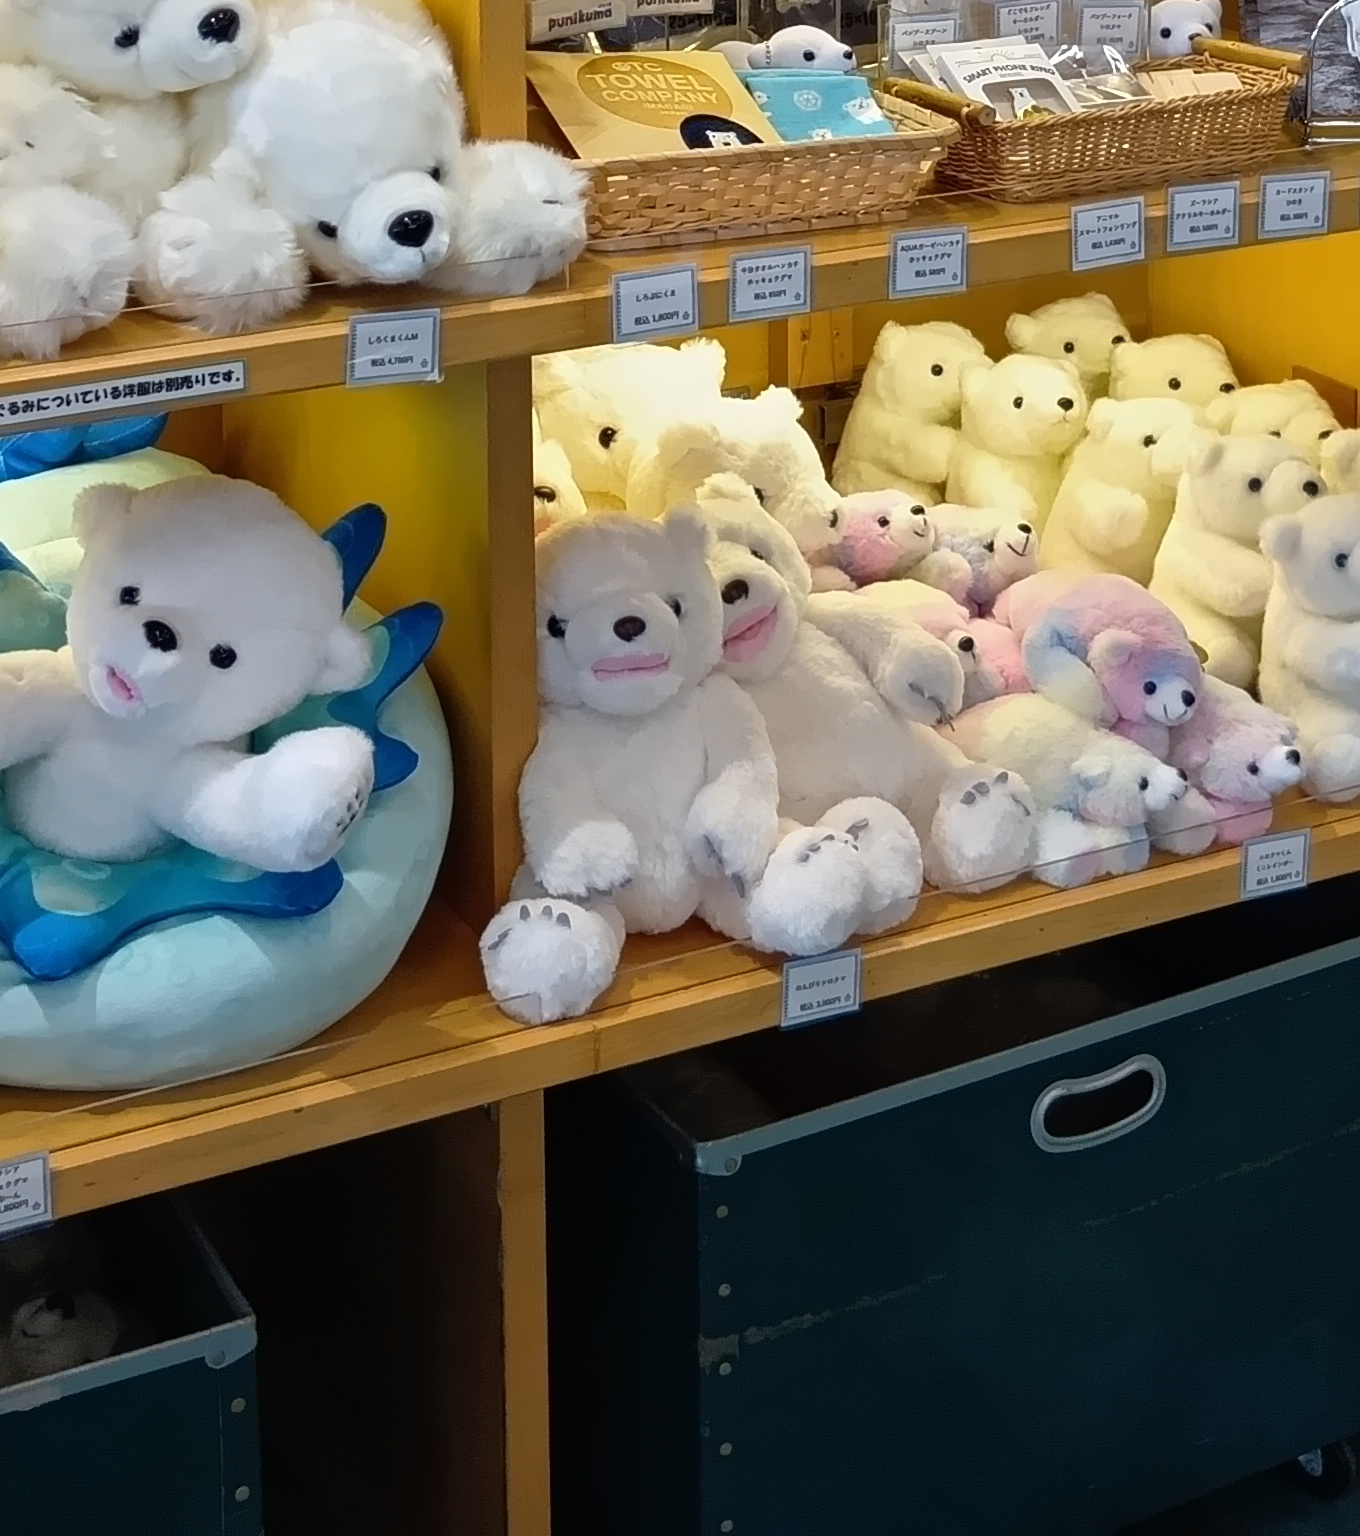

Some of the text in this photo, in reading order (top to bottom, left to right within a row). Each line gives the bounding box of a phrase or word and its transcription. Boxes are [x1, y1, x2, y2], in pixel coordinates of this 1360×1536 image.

[548, 7, 613, 31] punikuma
[962, 67, 993, 84] SMART
[992, 64, 1029, 72] PHONE
[585, 73, 714, 91] TOWEL
[601, 90, 719, 104] COMPANY
[1096, 213, 1120, 222] アニマル
[1175, 208, 1232, 220] アクリルキーホルダー
[1078, 221, 1138, 237] スマートフォンリング
[900, 239, 960, 252] AQUAガーゼハンカチ
[908, 252, 953, 263] ホッキョクグマ
[746, 273, 793, 286] ホッキョクグマ
[368, 332, 419, 345] しろくまくんM
[795, 975, 847, 992] のんびりシロクマ
